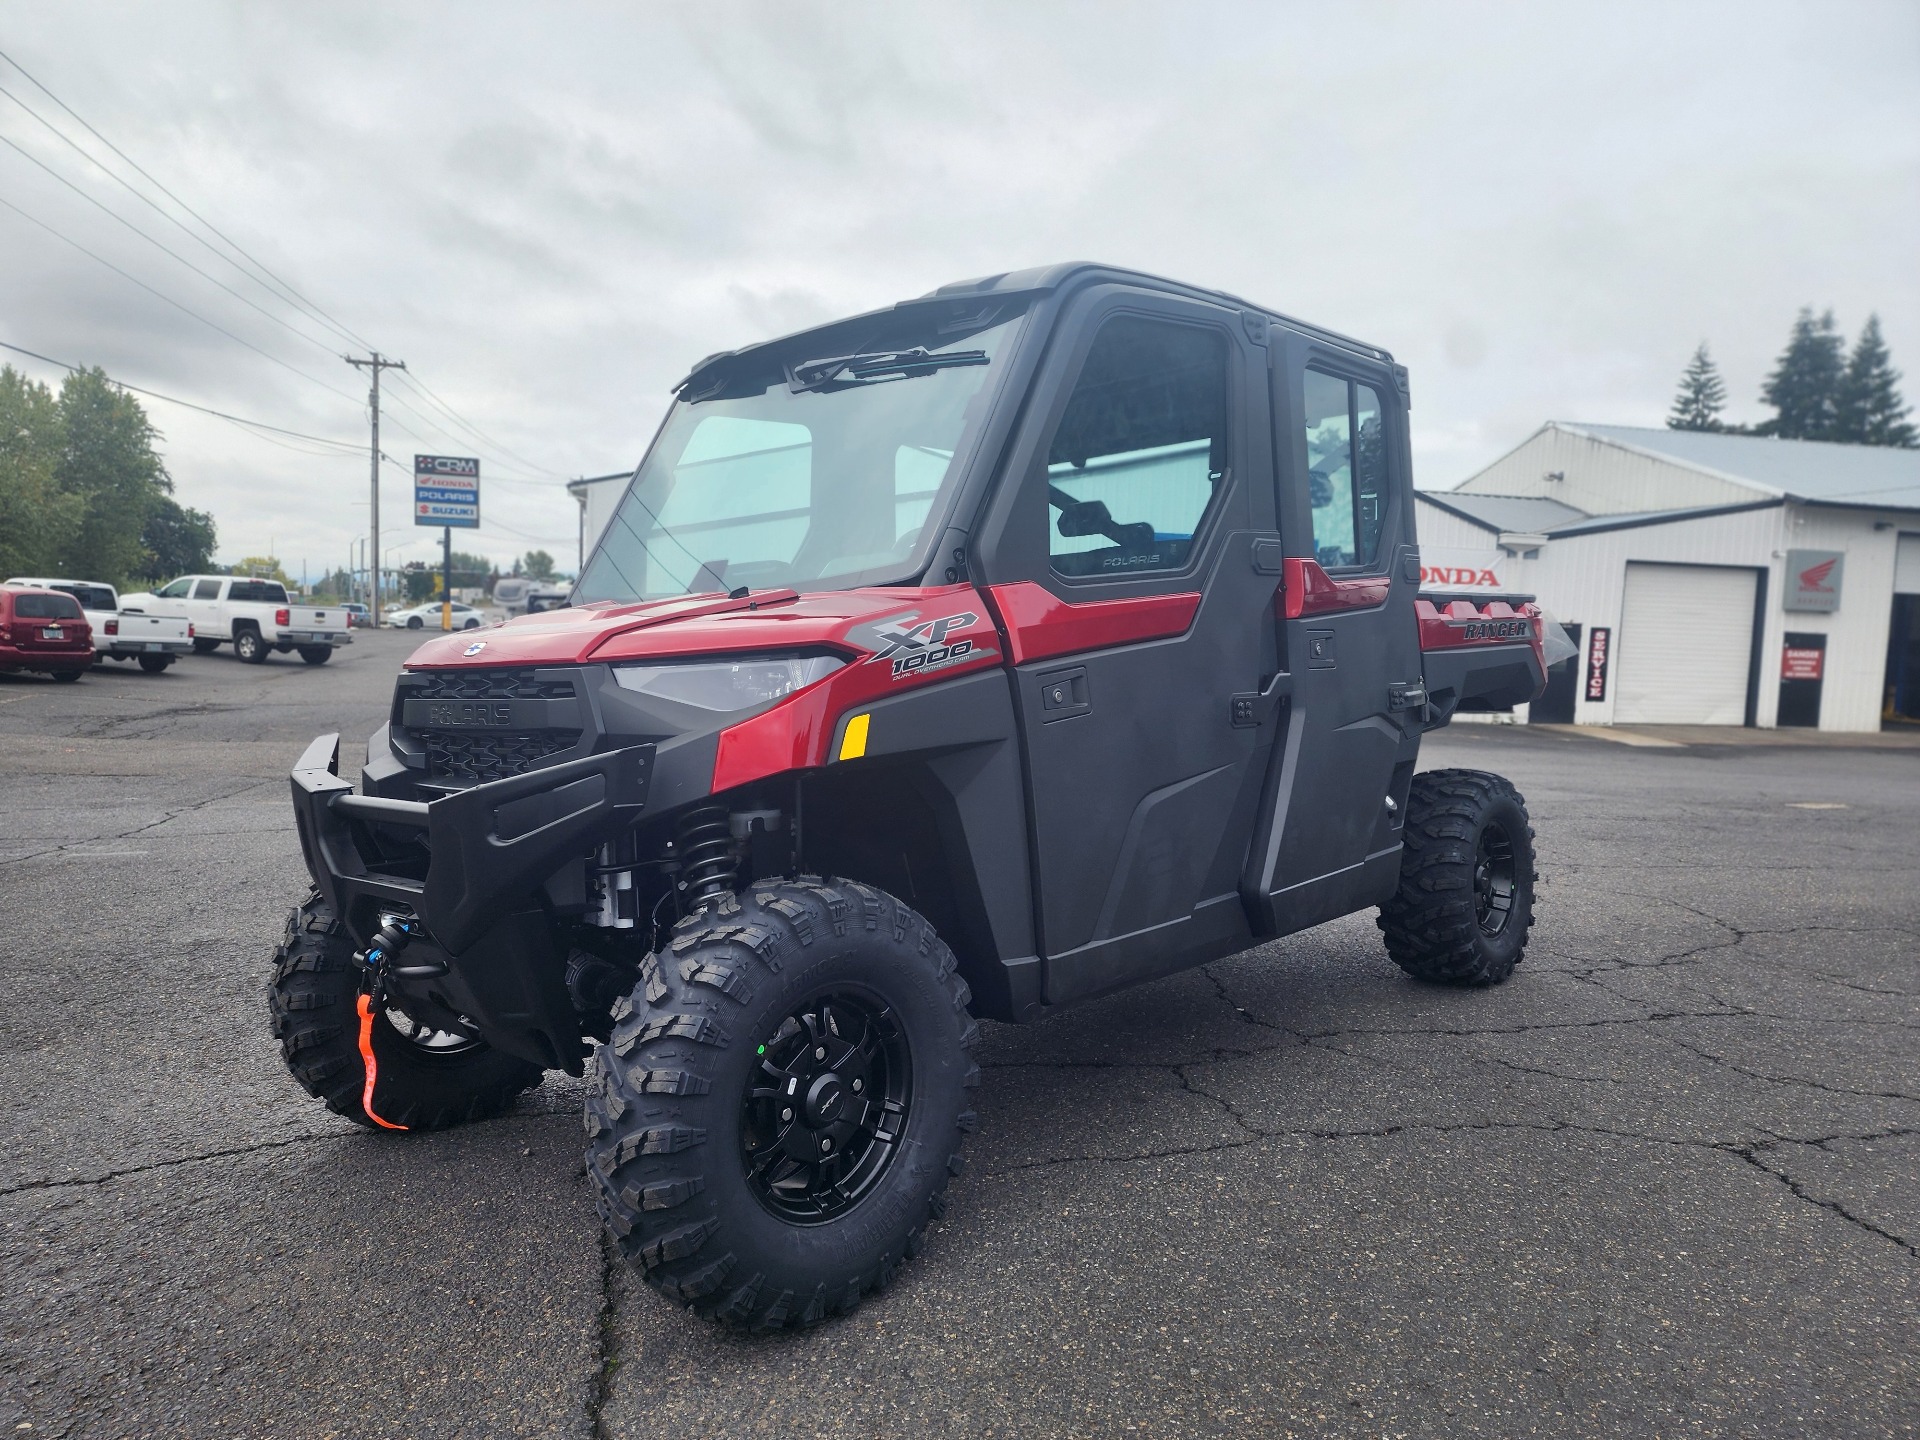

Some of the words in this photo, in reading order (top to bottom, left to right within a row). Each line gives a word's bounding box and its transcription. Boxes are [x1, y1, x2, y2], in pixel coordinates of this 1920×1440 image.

[434, 459, 475, 474] CRM
[432, 480, 473, 488] HONDA
[419, 491, 475, 501] POLARIS
[432, 506, 474, 515] SUZUKI
[1103, 554, 1160, 568] POLARIS
[862, 611, 980, 666] XP
[1463, 621, 1527, 640] RANGER
[891, 640, 973, 676] 1000
[1589, 630, 1606, 697] SERVICE
[429, 703, 511, 726] POLARIS
